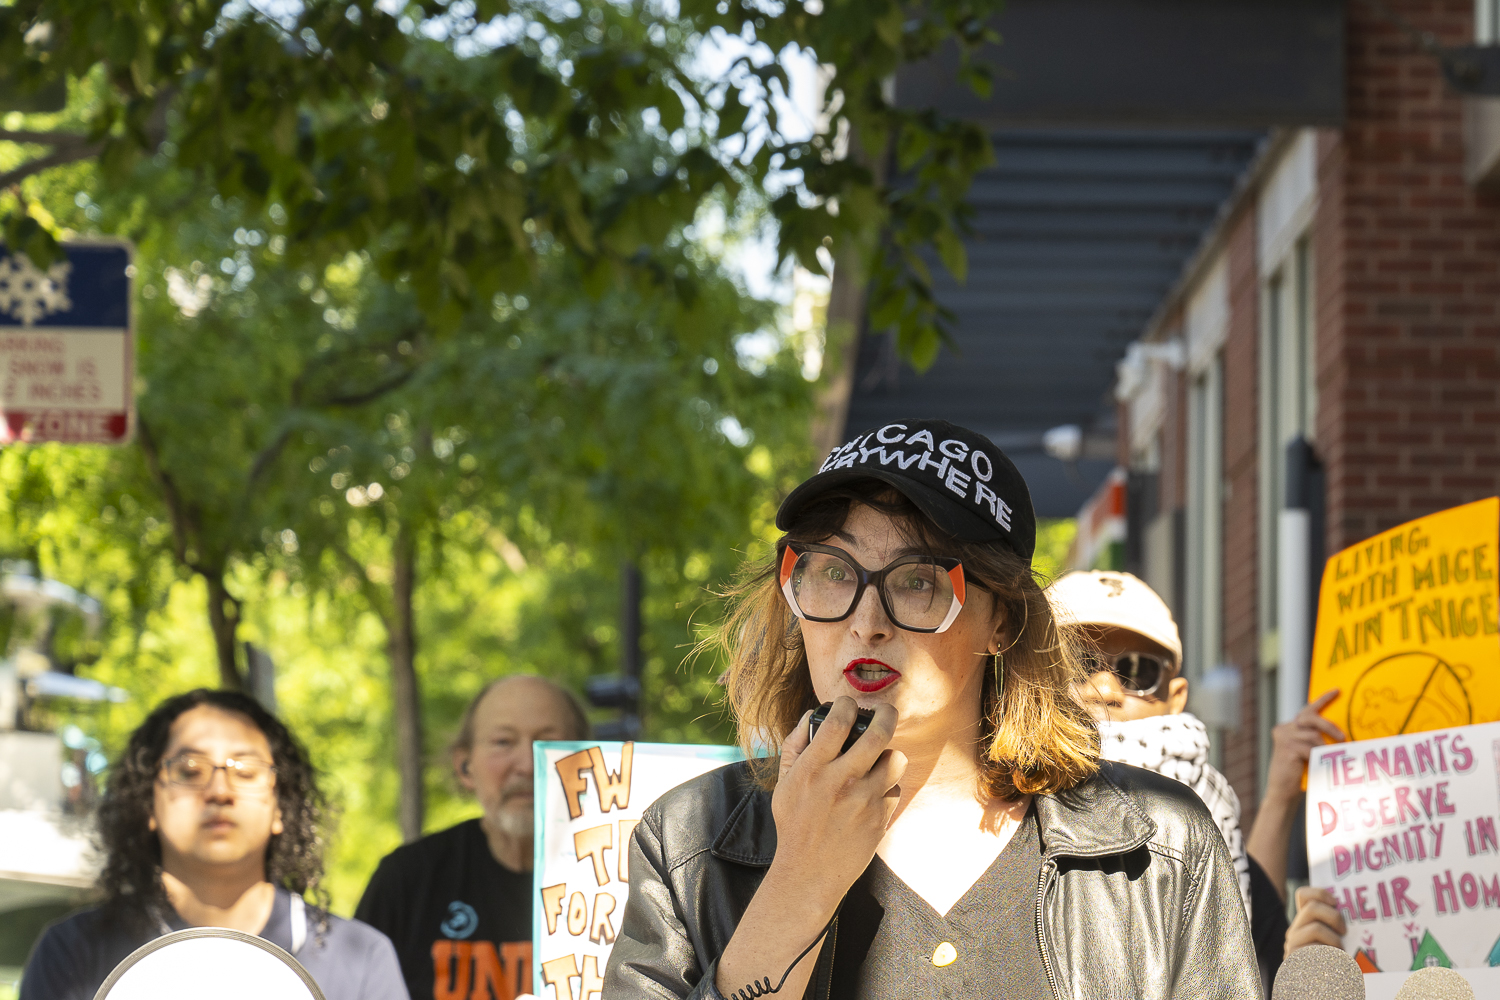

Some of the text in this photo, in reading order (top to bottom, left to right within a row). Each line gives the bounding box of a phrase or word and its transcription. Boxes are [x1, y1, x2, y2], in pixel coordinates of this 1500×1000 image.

[1335, 526, 1430, 582] LIVING
[1337, 543, 1493, 615] WITH MICE
[1417, 592, 1499, 645] NICE
[554, 740, 635, 821] FW
[1319, 733, 1476, 788] TENANTS
[1317, 781, 1457, 837] DESERVE
[1332, 816, 1500, 880] DIGNITY IN
[540, 882, 617, 946] FOR
[1325, 876, 1421, 924] HEIR
